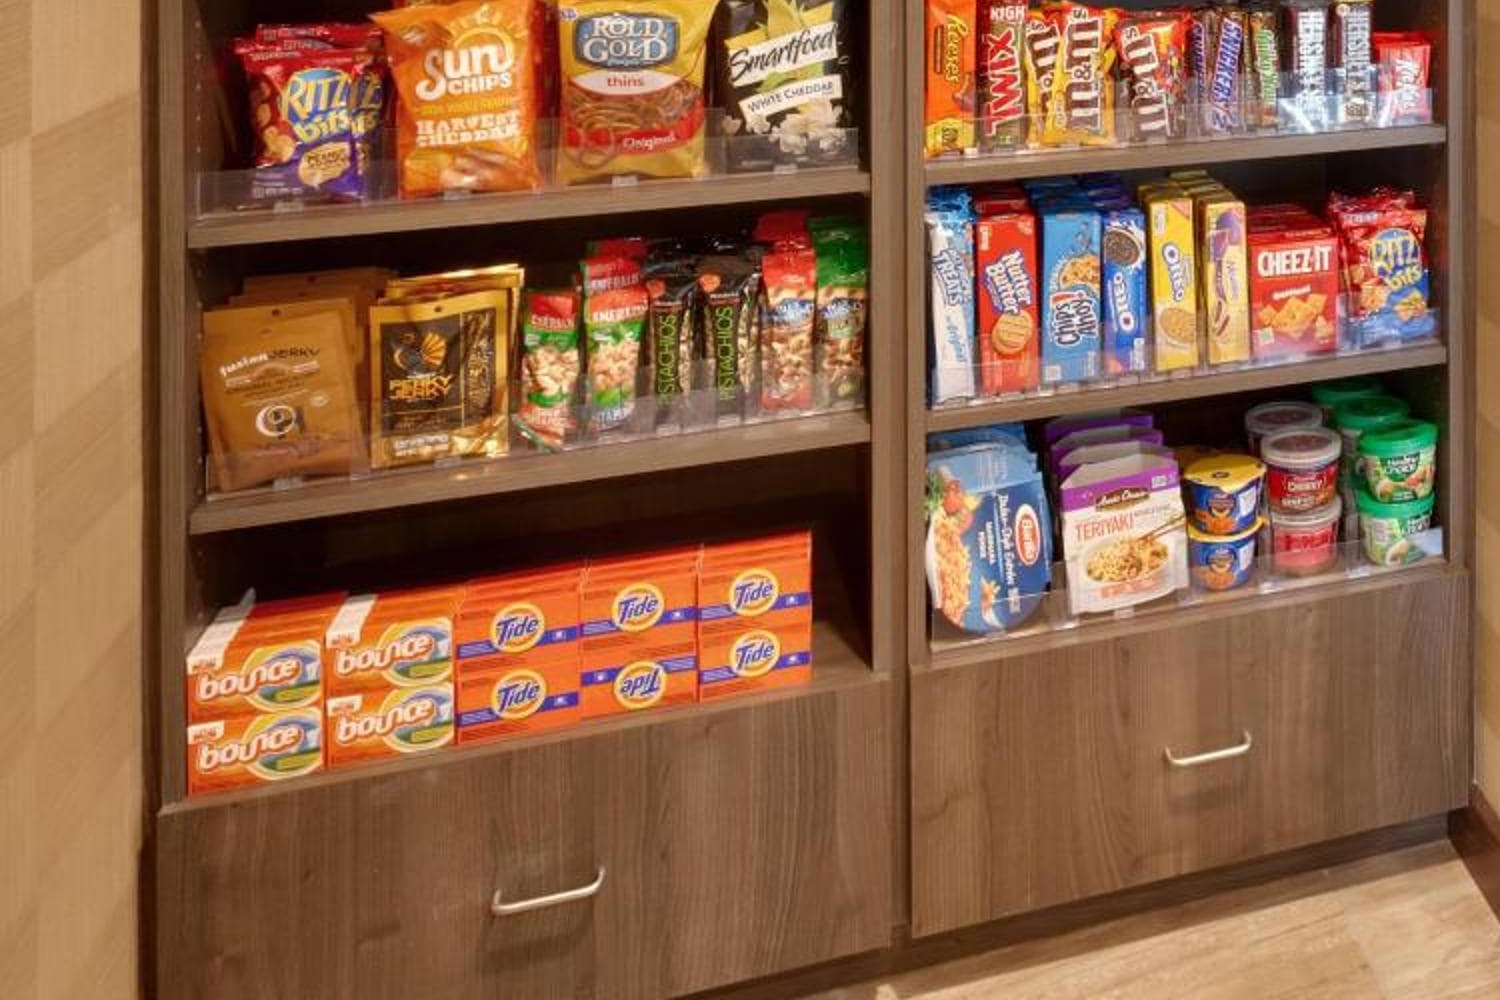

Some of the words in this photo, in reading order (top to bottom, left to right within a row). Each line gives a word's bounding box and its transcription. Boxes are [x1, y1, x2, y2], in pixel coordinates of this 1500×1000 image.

[592, 17, 665, 38] ROLD
[415, 41, 515, 101] Sun
[583, 36, 668, 64] GOLD
[730, 23, 838, 83] Smartfood
[1212, 18, 1243, 110] SNICKERS
[286, 75, 352, 119] RITZ
[444, 72, 513, 95] CHIPS
[606, 75, 645, 88] thins
[984, 28, 1025, 138] TWIX
[984, 261, 1019, 316] Butter
[1000, 249, 1032, 306] Nutter
[1162, 242, 1185, 301] OREO
[1112, 271, 1136, 332] OREO
[1074, 512, 1134, 542] TERIYAKI
[618, 596, 660, 625] Tide
[735, 581, 774, 609] Tide
[495, 616, 540, 644] Tide
[336, 633, 436, 676] bounce
[735, 642, 775, 670] Tide
[197, 656, 301, 700] bounce
[496, 682, 542, 712] Tide
[337, 698, 436, 744] bounce
[198, 726, 302, 772] bounce
